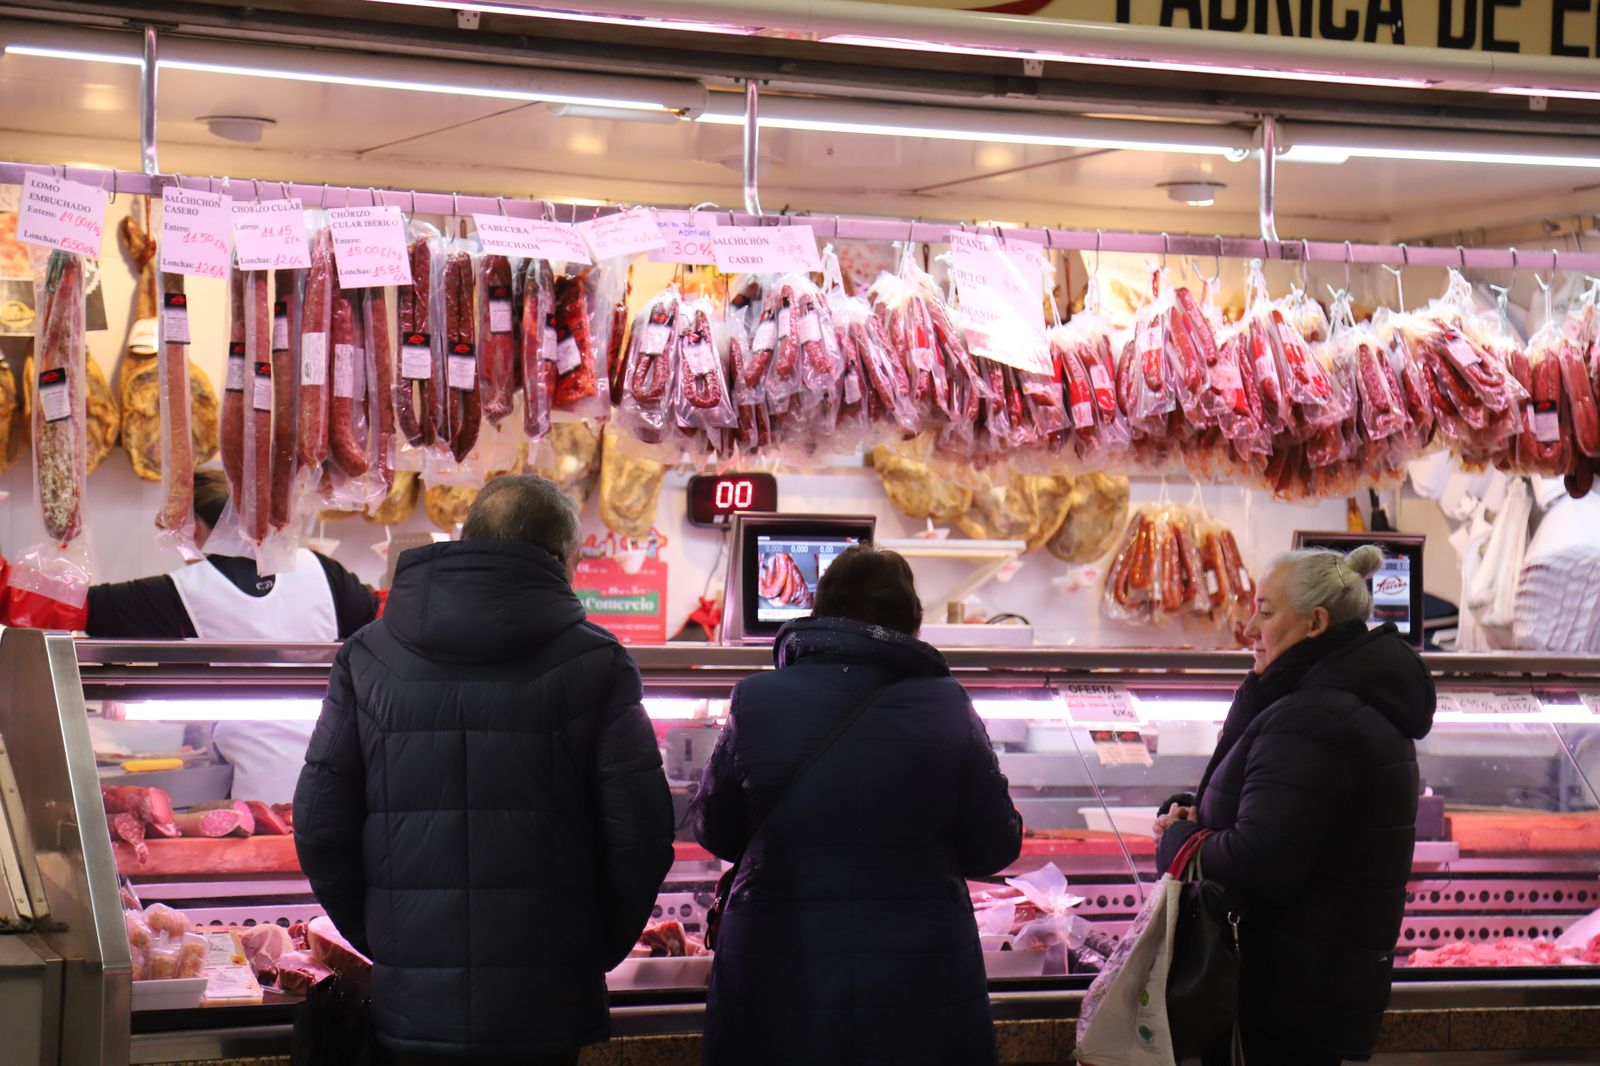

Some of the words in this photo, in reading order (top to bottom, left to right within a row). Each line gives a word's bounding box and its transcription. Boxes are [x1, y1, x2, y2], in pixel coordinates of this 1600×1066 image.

[31, 180, 60, 192] LOMO
[29, 192, 91, 213] EMBUCHADO
[231, 205, 270, 213] CHORIZO
[271, 203, 301, 212] CULAR
[27, 205, 57, 218] Entero:
[164, 204, 199, 216] CASERO
[331, 210, 370, 219] CHORIZO
[164, 222, 191, 233] Entero:
[332, 220, 362, 229] CULAR
[480, 223, 529, 235] CABECERA
[23, 230, 59, 245] Lonchas:
[335, 237, 361, 245] Entero:
[482, 239, 541, 251] EMBUCHADA
[163, 258, 195, 269] Lonchas:
[240, 256, 272, 264] Lonchas:
[728, 255, 764, 264] CASERO
[339, 268, 372, 276] Lonchas:
[957, 269, 987, 285] DULCE
[715, 481, 753, 508] 00
[790, 544, 809, 553] 0.000
[819, 545, 834, 554] 0.00
[585, 597, 655, 612] Comercio
[1068, 684, 1116, 694] OFERTA
